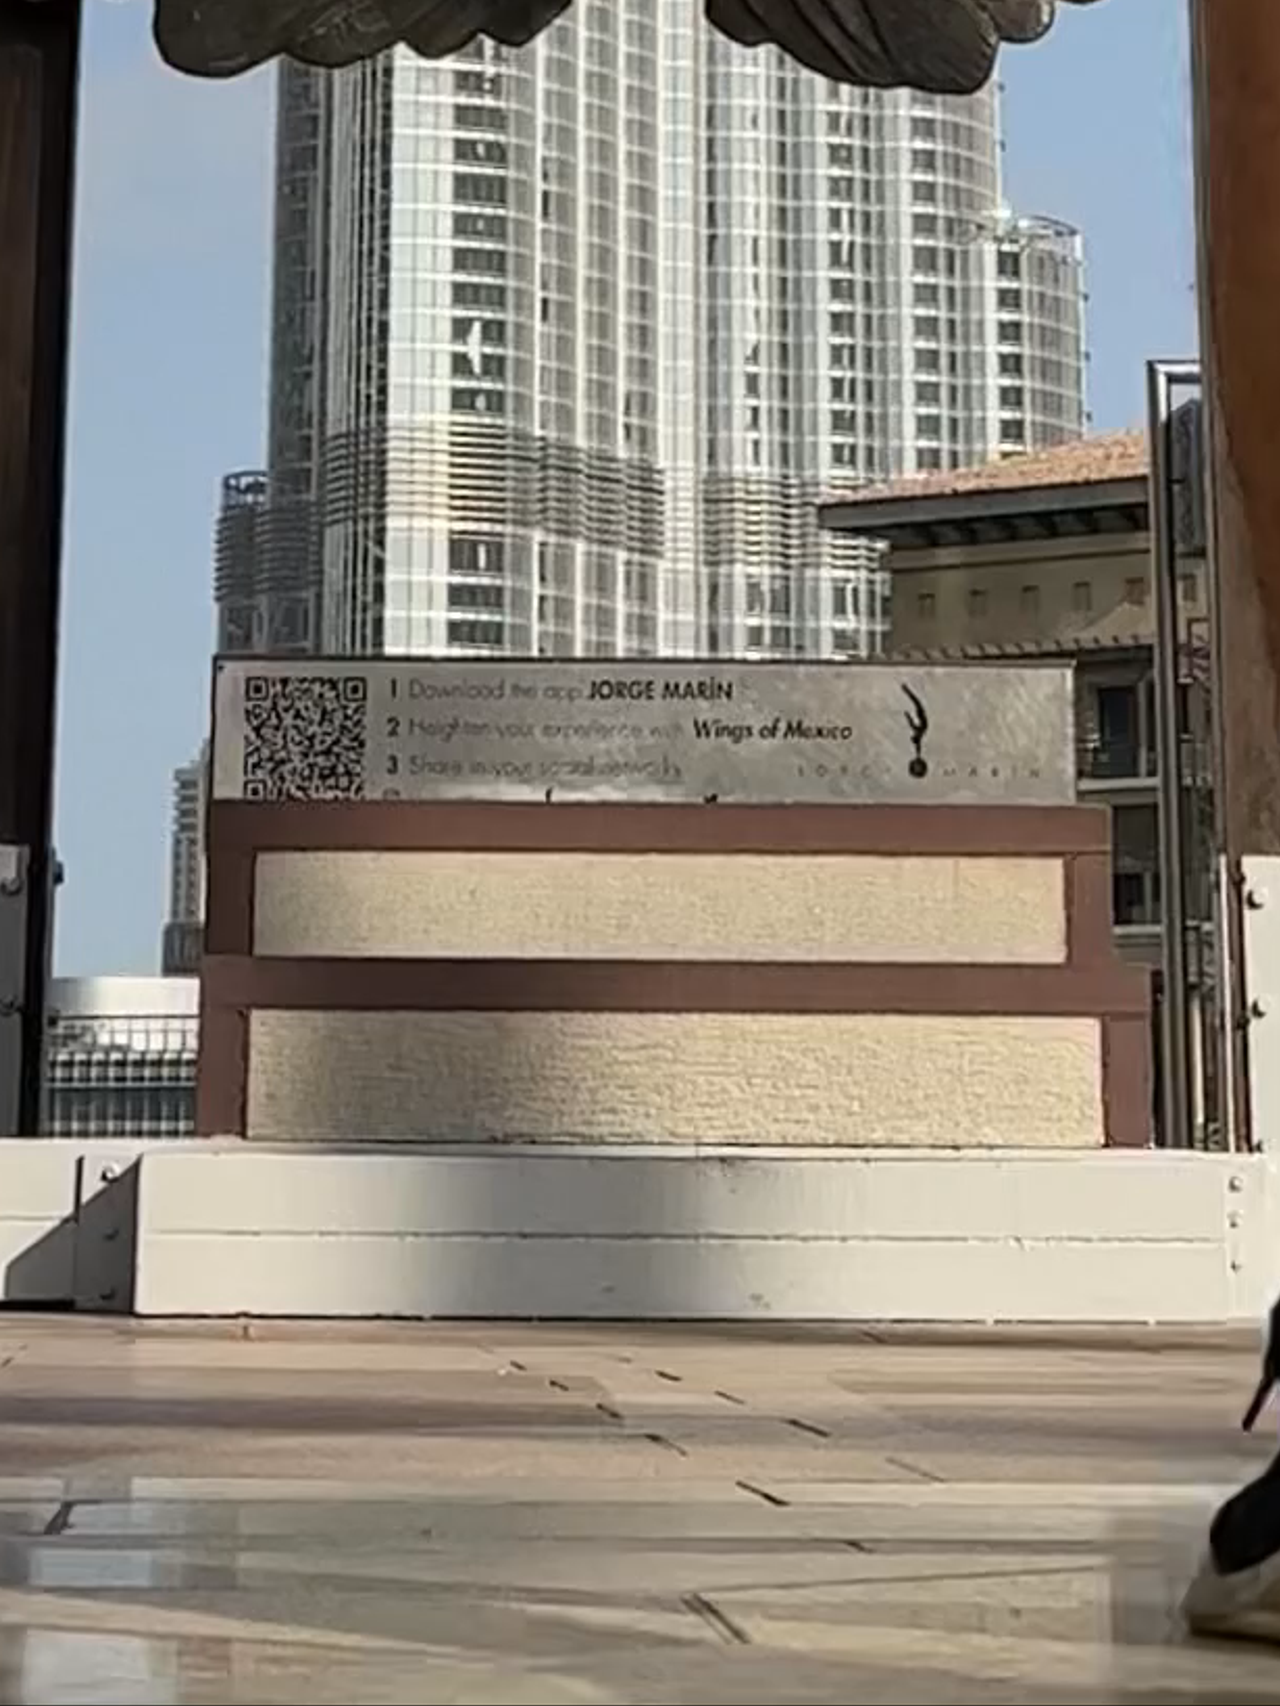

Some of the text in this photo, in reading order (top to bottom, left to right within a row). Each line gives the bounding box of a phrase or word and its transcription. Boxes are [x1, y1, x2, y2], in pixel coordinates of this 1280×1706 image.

[390, 678, 398, 698] 1
[409, 677, 505, 700] Download
[588, 679, 656, 700] JORGE
[386, 717, 401, 737] 2
[693, 717, 754, 744] Wings
[758, 717, 781, 739] of
[783, 719, 853, 740] Mexico
[386, 755, 399, 775] 3
